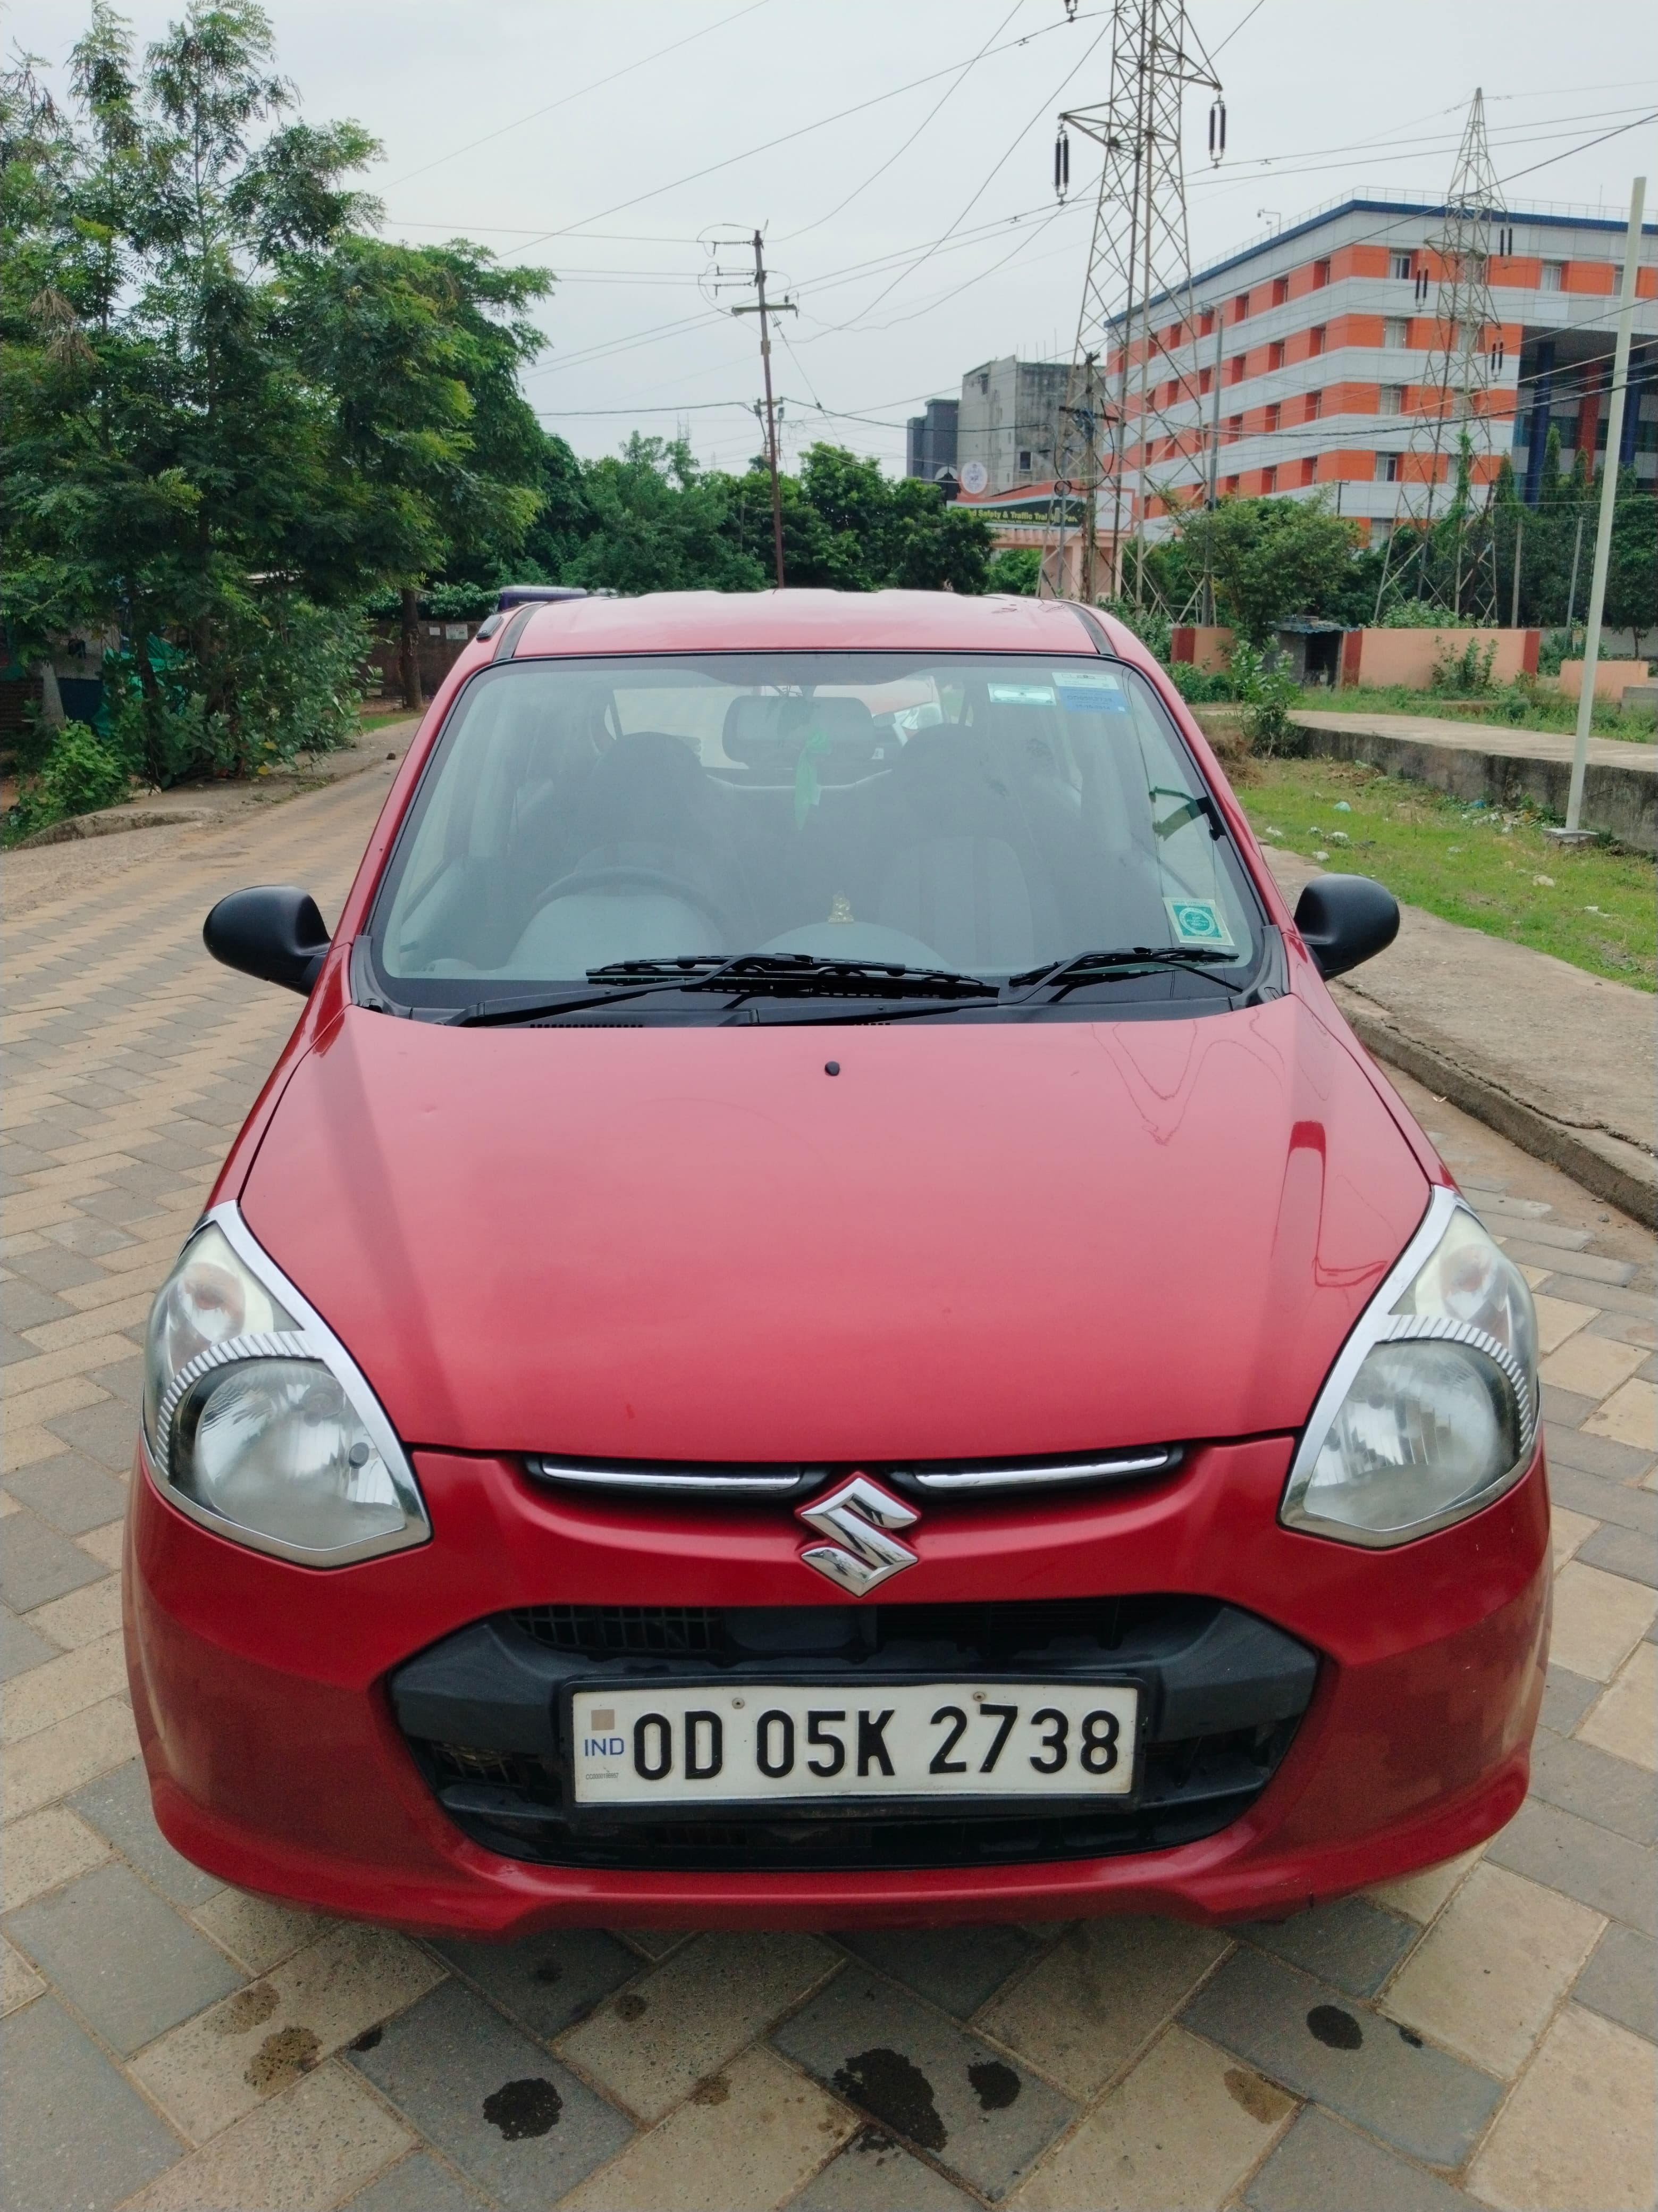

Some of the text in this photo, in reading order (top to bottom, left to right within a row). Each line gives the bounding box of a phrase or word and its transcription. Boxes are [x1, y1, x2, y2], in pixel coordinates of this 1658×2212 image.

[1011, 511, 1032, 520] Traffic
[584, 1737, 625, 1757] IND
[633, 1704, 1120, 1781] OD 05K 2738
